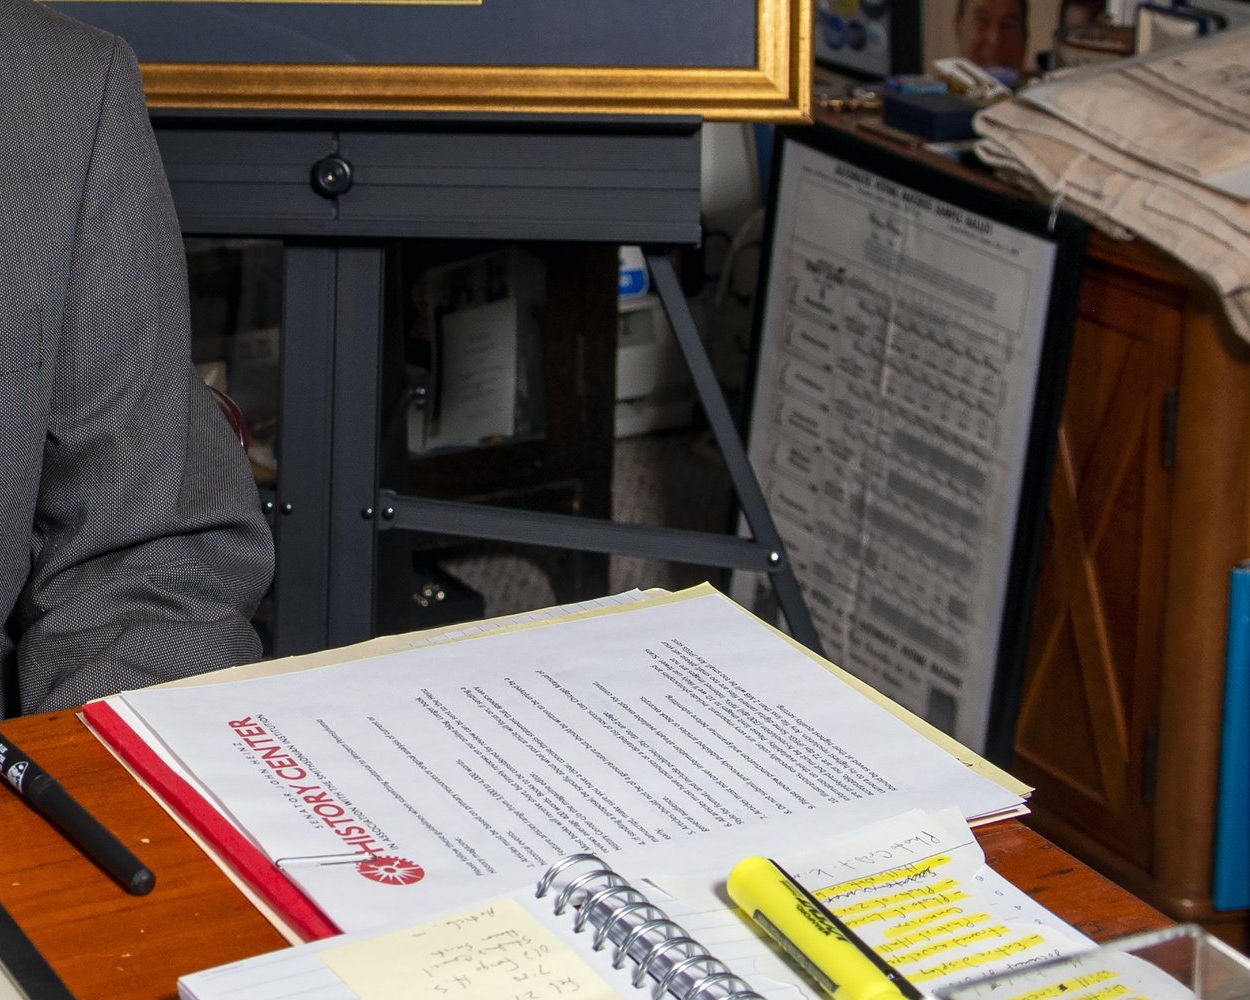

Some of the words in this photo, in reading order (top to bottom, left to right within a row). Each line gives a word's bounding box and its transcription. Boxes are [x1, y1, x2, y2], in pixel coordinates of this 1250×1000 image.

[617, 701, 635, 714] except
[633, 714, 656, 730] available
[659, 712, 674, 722] book
[255, 714, 290, 743] INSTITUTION
[371, 720, 390, 735] current
[677, 726, 698, 740] articles
[654, 730, 674, 744] already
[229, 717, 305, 779] CENTER
[232, 742, 259, 764] HEINZ
[341, 743, 360, 759] Western
[392, 739, 411, 754] analysis
[694, 740, 723, 760] published
[287, 745, 326, 779] SMITHSONIAN
[406, 754, 427, 769] original
[672, 744, 703, 768] information
[260, 768, 284, 788] JOHN
[362, 764, 383, 781] material
[701, 769, 718, 780] cover
[720, 760, 750, 781] previously
[321, 780, 336, 791] THE
[430, 774, 453, 793] resources
[715, 780, 728, 788] not
[746, 780, 767, 795] submit
[333, 791, 352, 806] WITH
[380, 781, 406, 802] submitting
[725, 787, 741, 799] must
[764, 795, 777, 803] not
[403, 803, 418, 814] when
[451, 793, 472, 809] primary
[501, 799, 515, 810] from
[739, 799, 761, 814] Articles
[283, 793, 323, 828] SENATOR
[513, 810, 529, 823] range
[290, 785, 382, 854] HISTORY
[350, 807, 390, 841] ASSOCIATION
[416, 814, 442, 835] guidelines
[473, 816, 492, 829] based
[527, 823, 547, 838] articles
[438, 835, 453, 847] these
[495, 834, 510, 846] must
[544, 838, 565, 855] Feature
[451, 848, 468, 861] follow
[508, 846, 529, 862] Articles
[465, 861, 483, 875] Please
